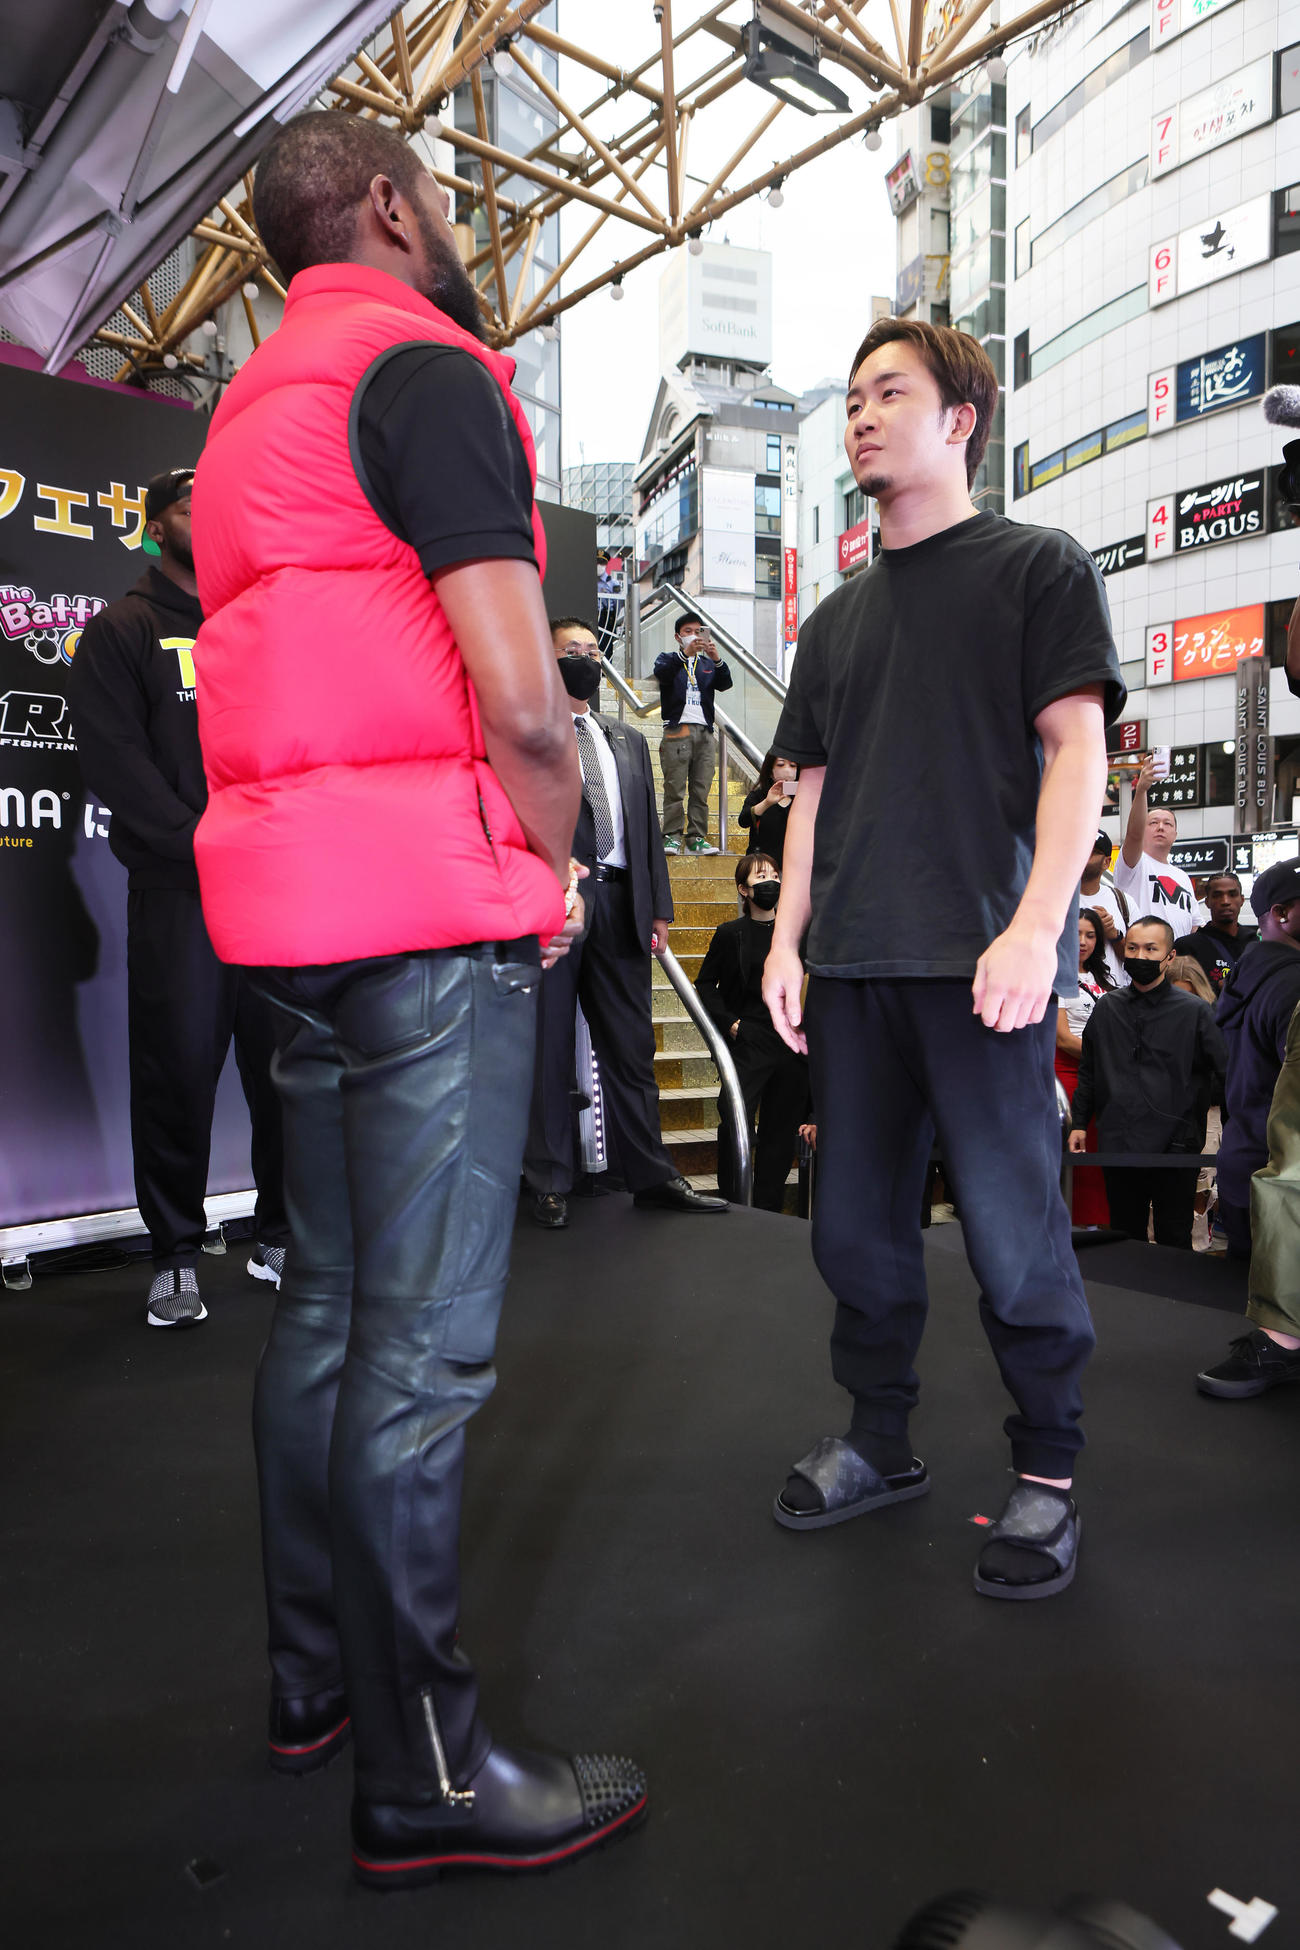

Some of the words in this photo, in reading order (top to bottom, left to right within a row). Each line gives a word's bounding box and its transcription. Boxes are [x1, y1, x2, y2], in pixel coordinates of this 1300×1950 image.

[701, 317, 758, 340] SoftBank
[1202, 499, 1242, 520] PARTY
[1180, 510, 1260, 548] BAGUS
[1238, 734, 1247, 775] LOUIS
[1257, 734, 1267, 775] LOUIS
